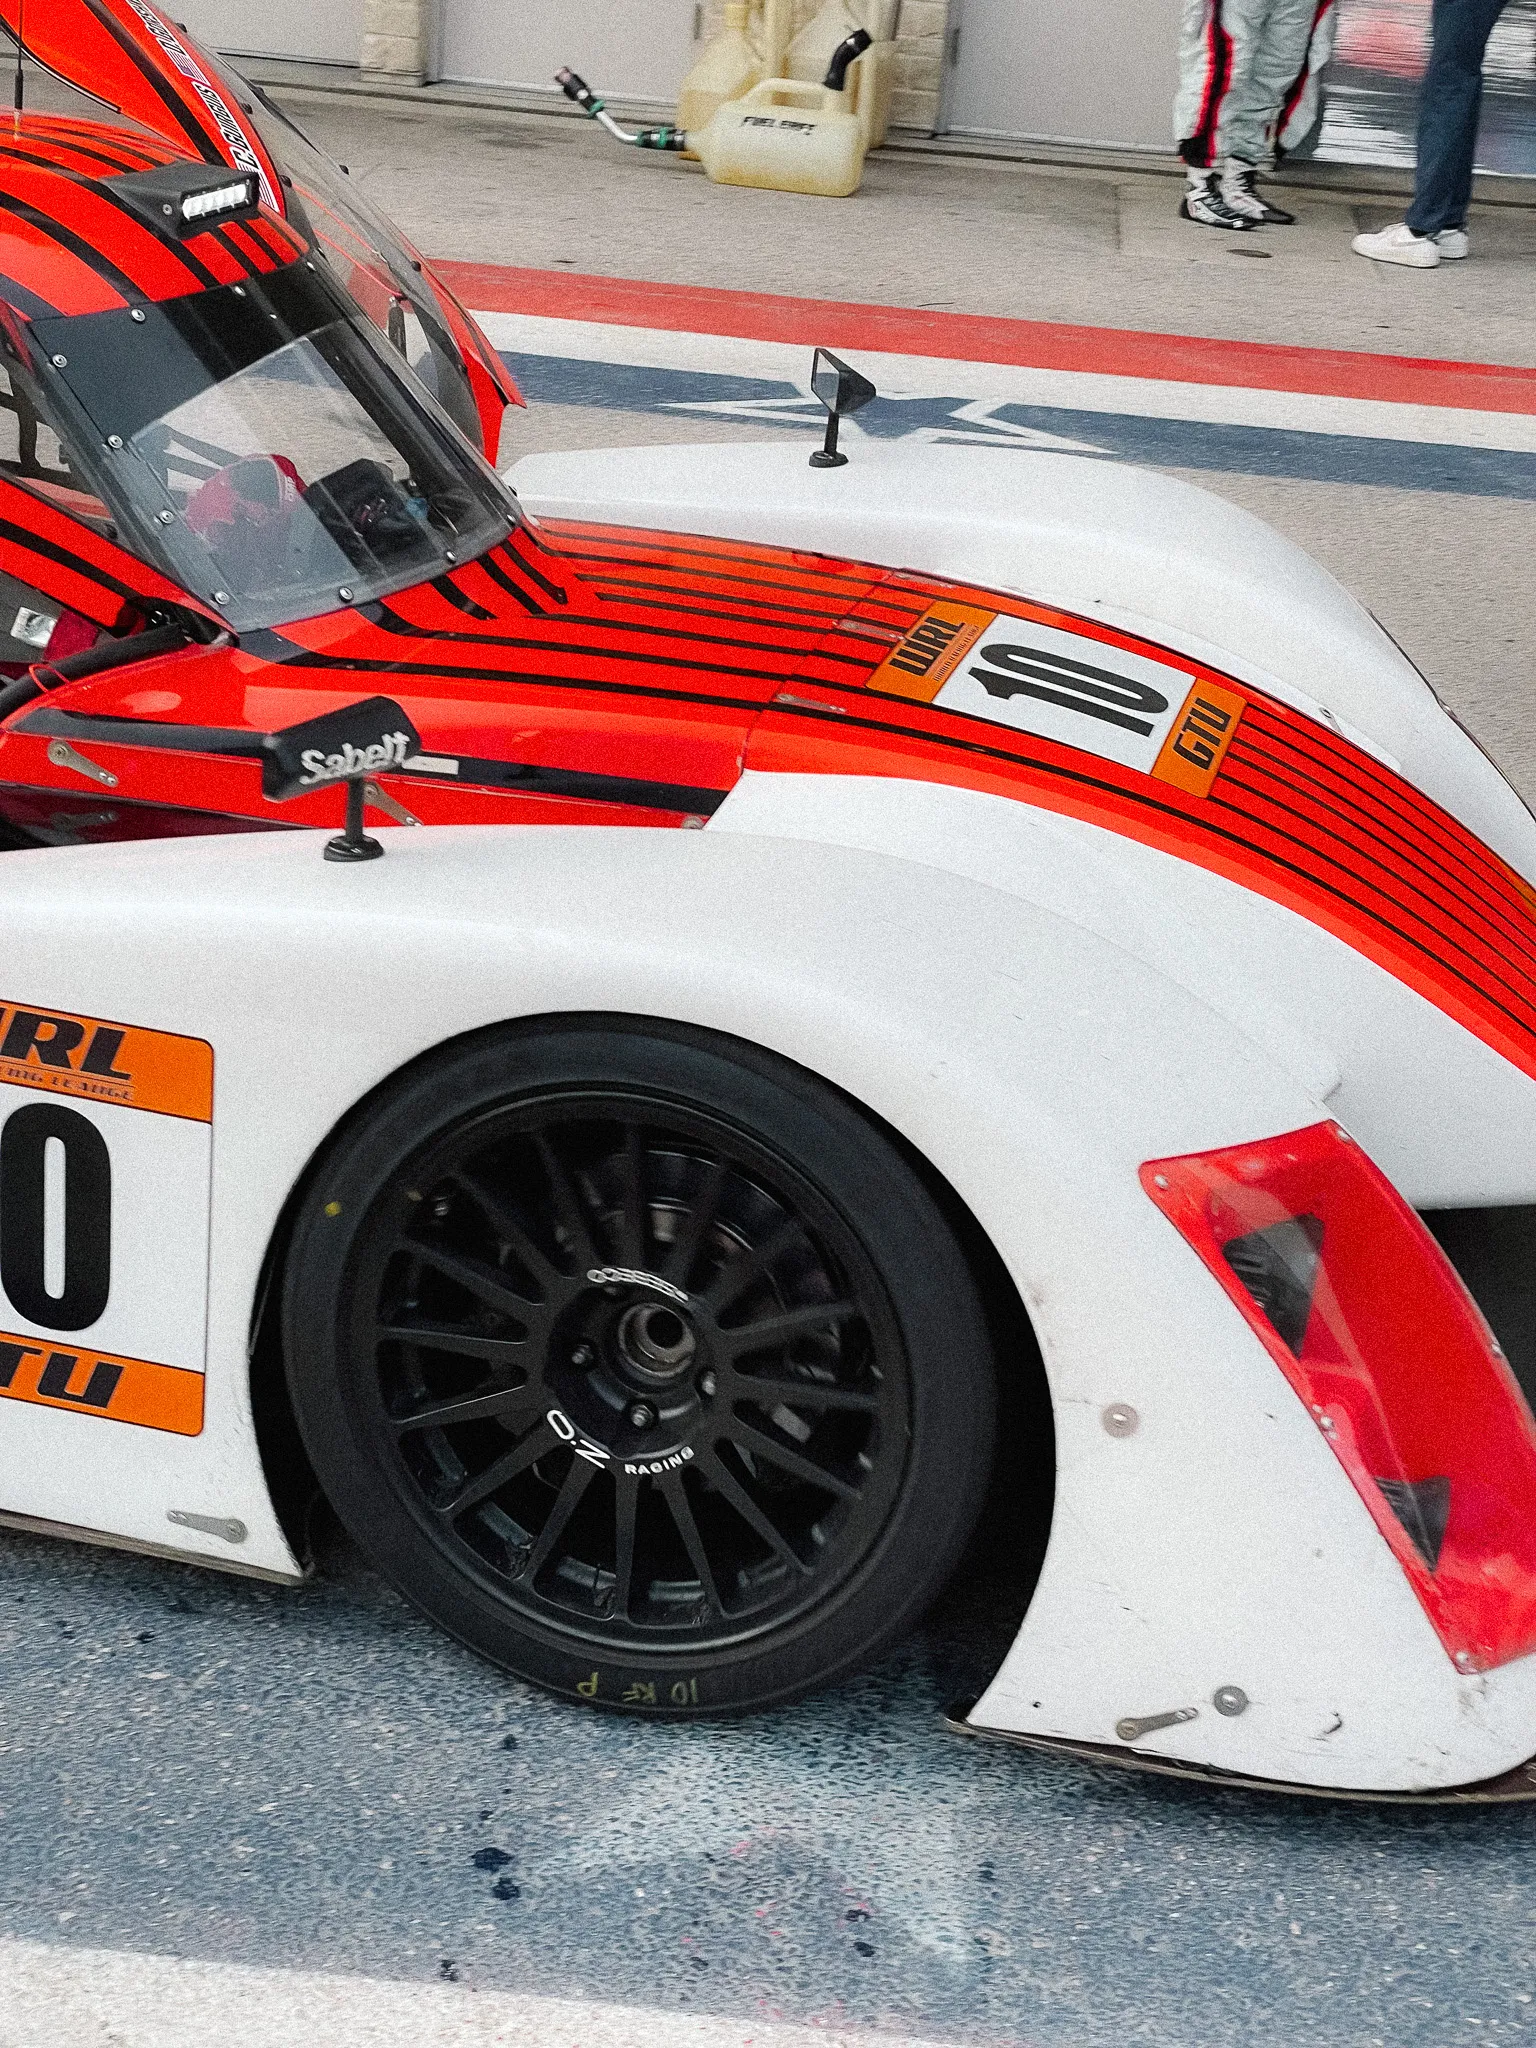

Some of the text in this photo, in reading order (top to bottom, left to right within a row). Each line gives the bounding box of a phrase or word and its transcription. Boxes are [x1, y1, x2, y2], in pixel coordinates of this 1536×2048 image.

[888, 616, 966, 677] WRL
[968, 643, 1169, 738] 10
[299, 731, 411, 786] Sabelt
[1171, 697, 1233, 770] GTU
[0, 1006, 132, 1080] RL
[624, 1446, 695, 1475] RACING
